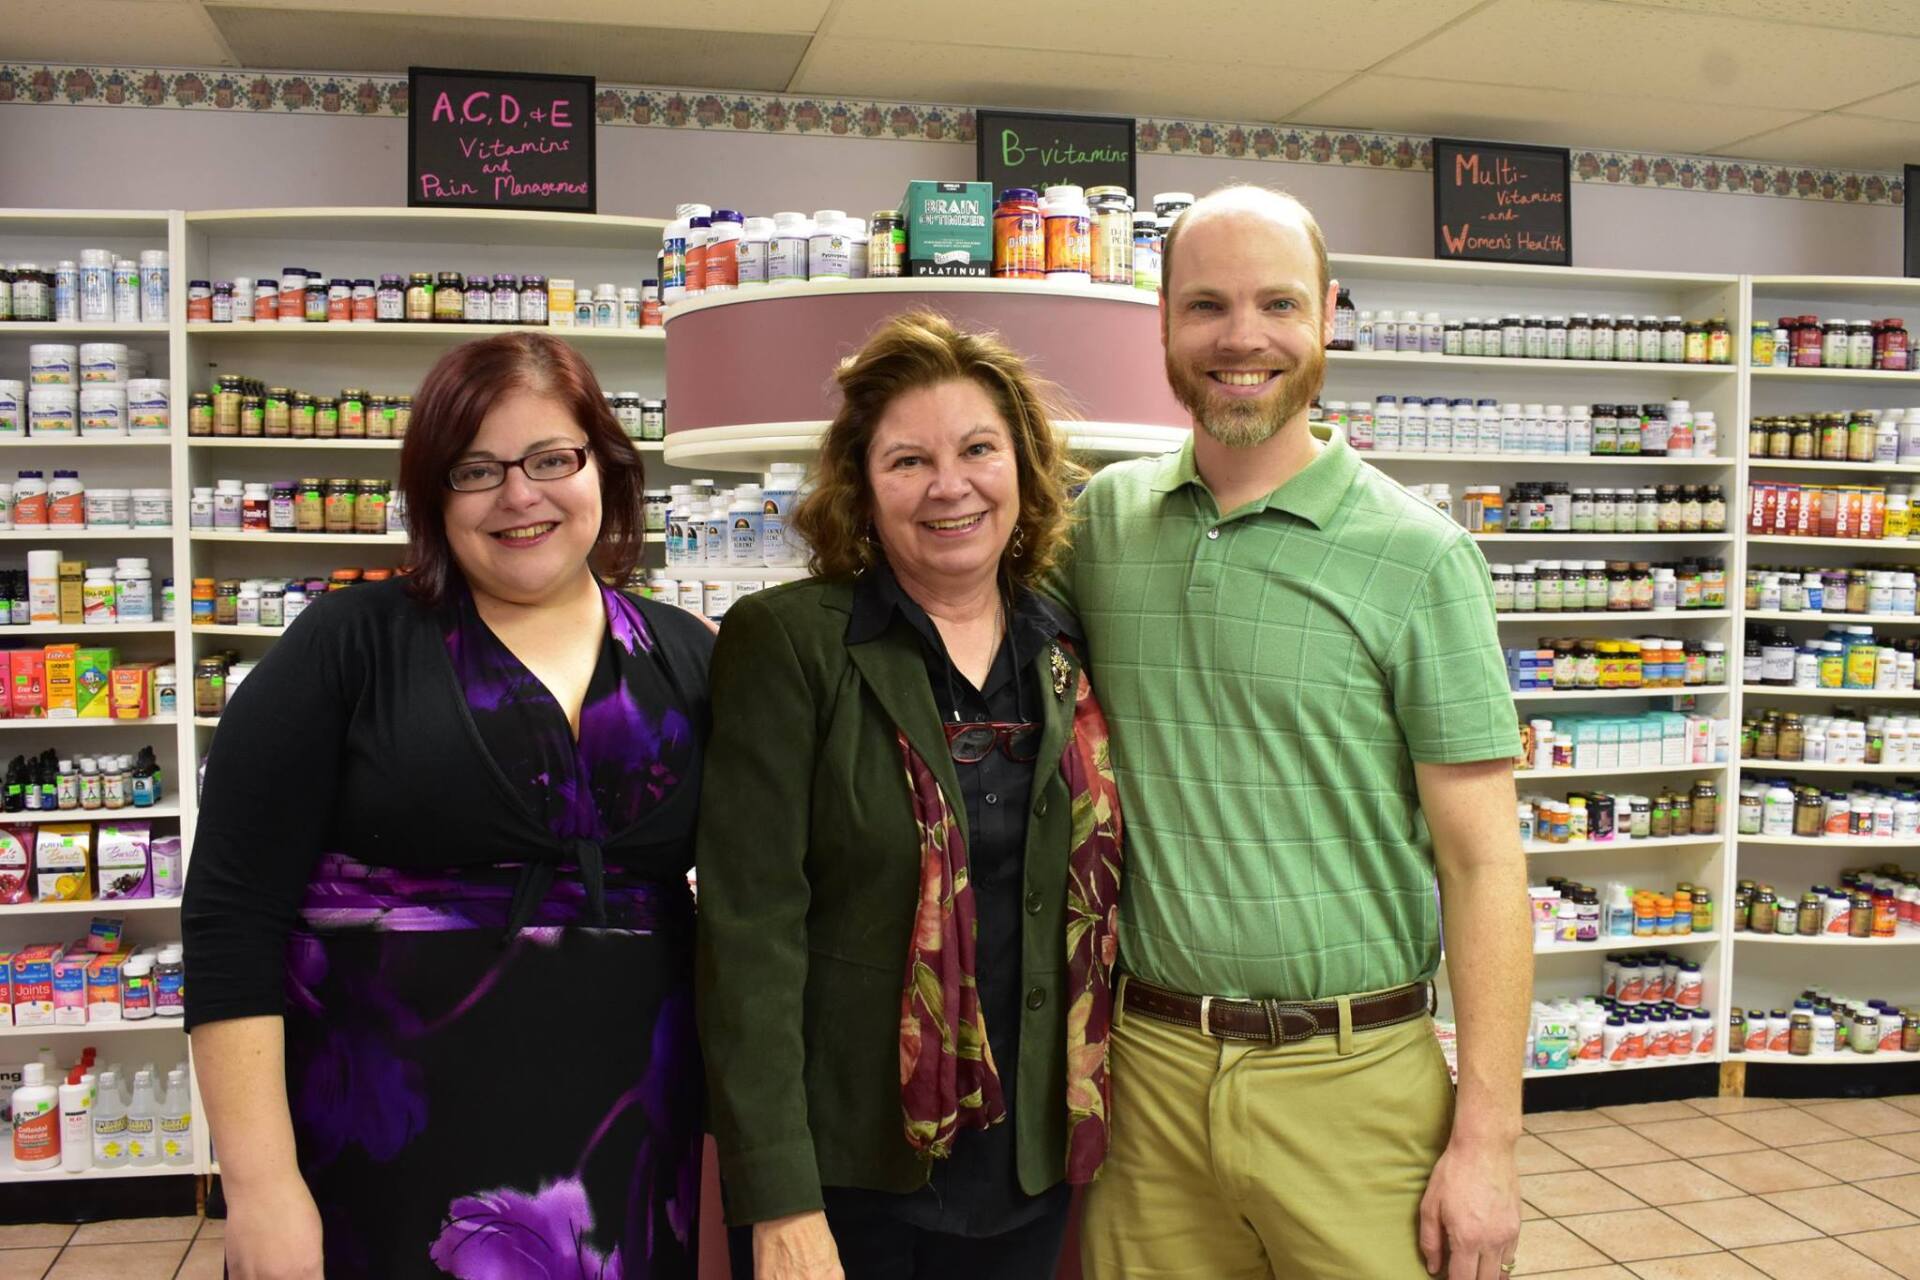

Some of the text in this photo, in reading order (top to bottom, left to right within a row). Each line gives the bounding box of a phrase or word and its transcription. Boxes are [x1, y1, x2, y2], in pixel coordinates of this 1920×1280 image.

[459, 136, 570, 159] Vitamins
[482, 159, 511, 174] and
[1455, 153, 1528, 186] Multi-
[420, 173, 589, 200] Pain Management
[924, 199, 980, 214] BRAIN
[919, 214, 986, 227] OPTIMIZER
[1442, 223, 1566, 255] Women's Health
[919, 266, 986, 276] PLATINUM
[16, 984, 51, 996] Joints
